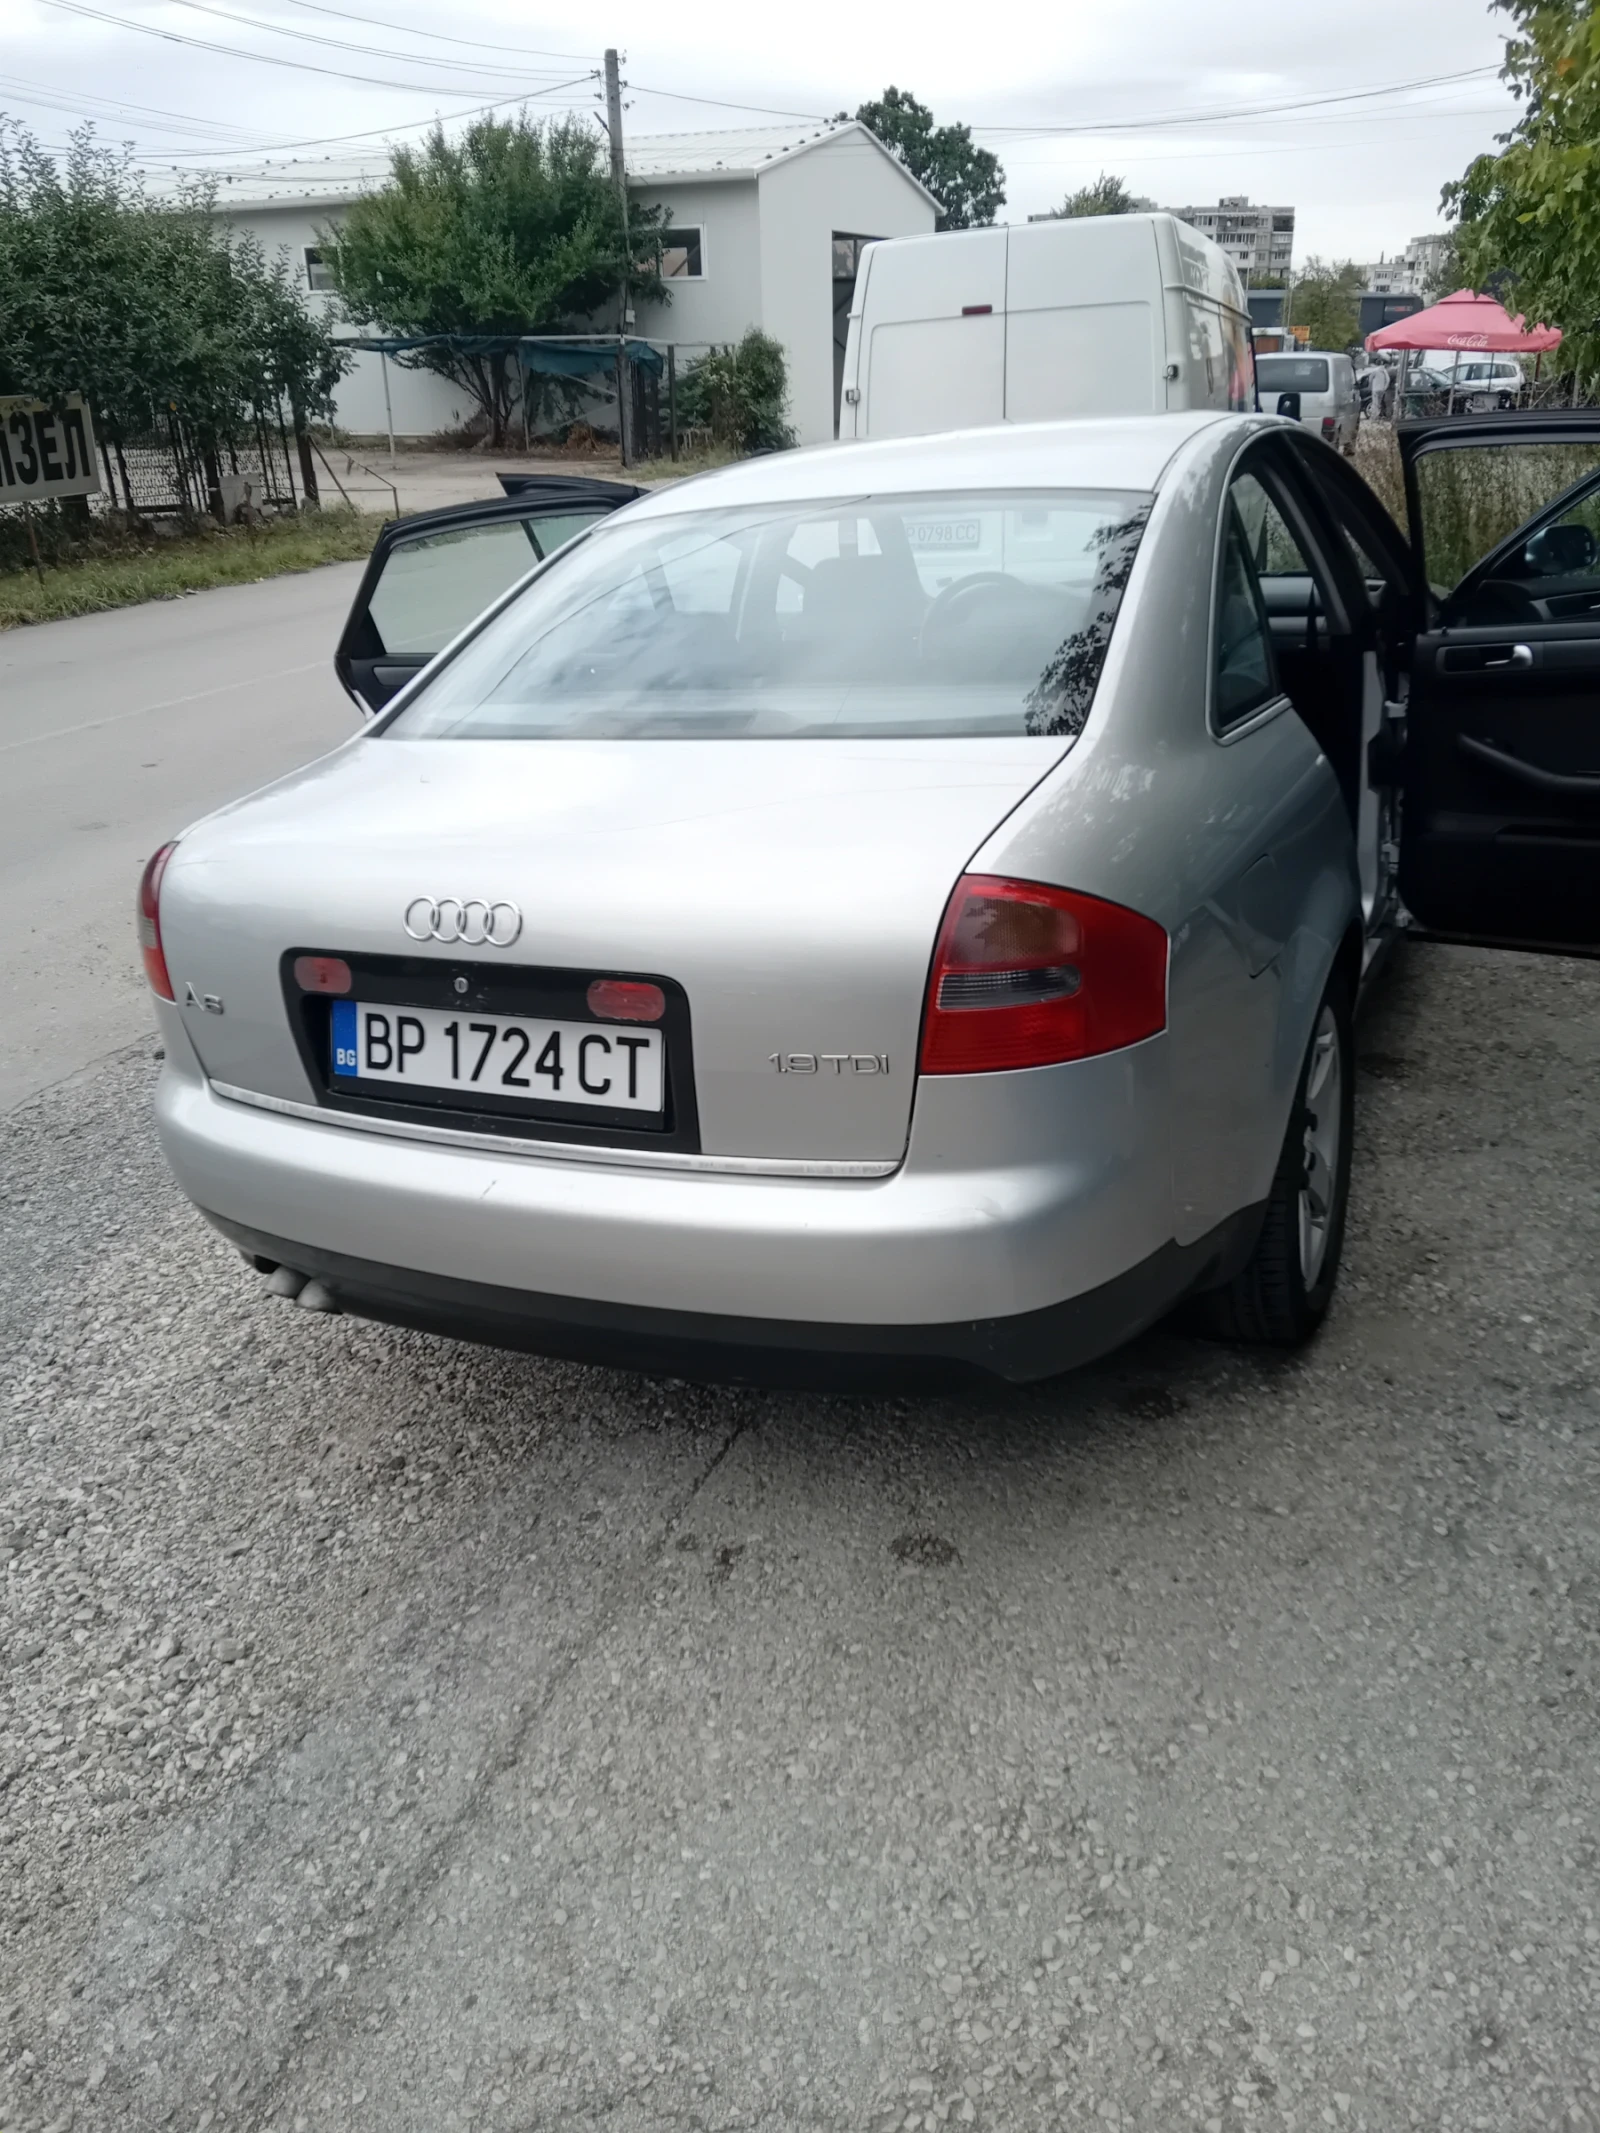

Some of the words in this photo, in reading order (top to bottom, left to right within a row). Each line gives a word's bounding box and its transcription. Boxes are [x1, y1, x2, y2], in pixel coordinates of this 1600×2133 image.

[917, 525, 953, 541] 0798
[955, 524, 976, 540] CC
[185, 981, 224, 1015] A6
[336, 1049, 357, 1066] BG
[365, 1013, 425, 1073] BP
[444, 1021, 564, 1090] 1724
[578, 1034, 650, 1098] CT
[768, 1053, 818, 1074] 1.9
[820, 1054, 889, 1074] TDI
